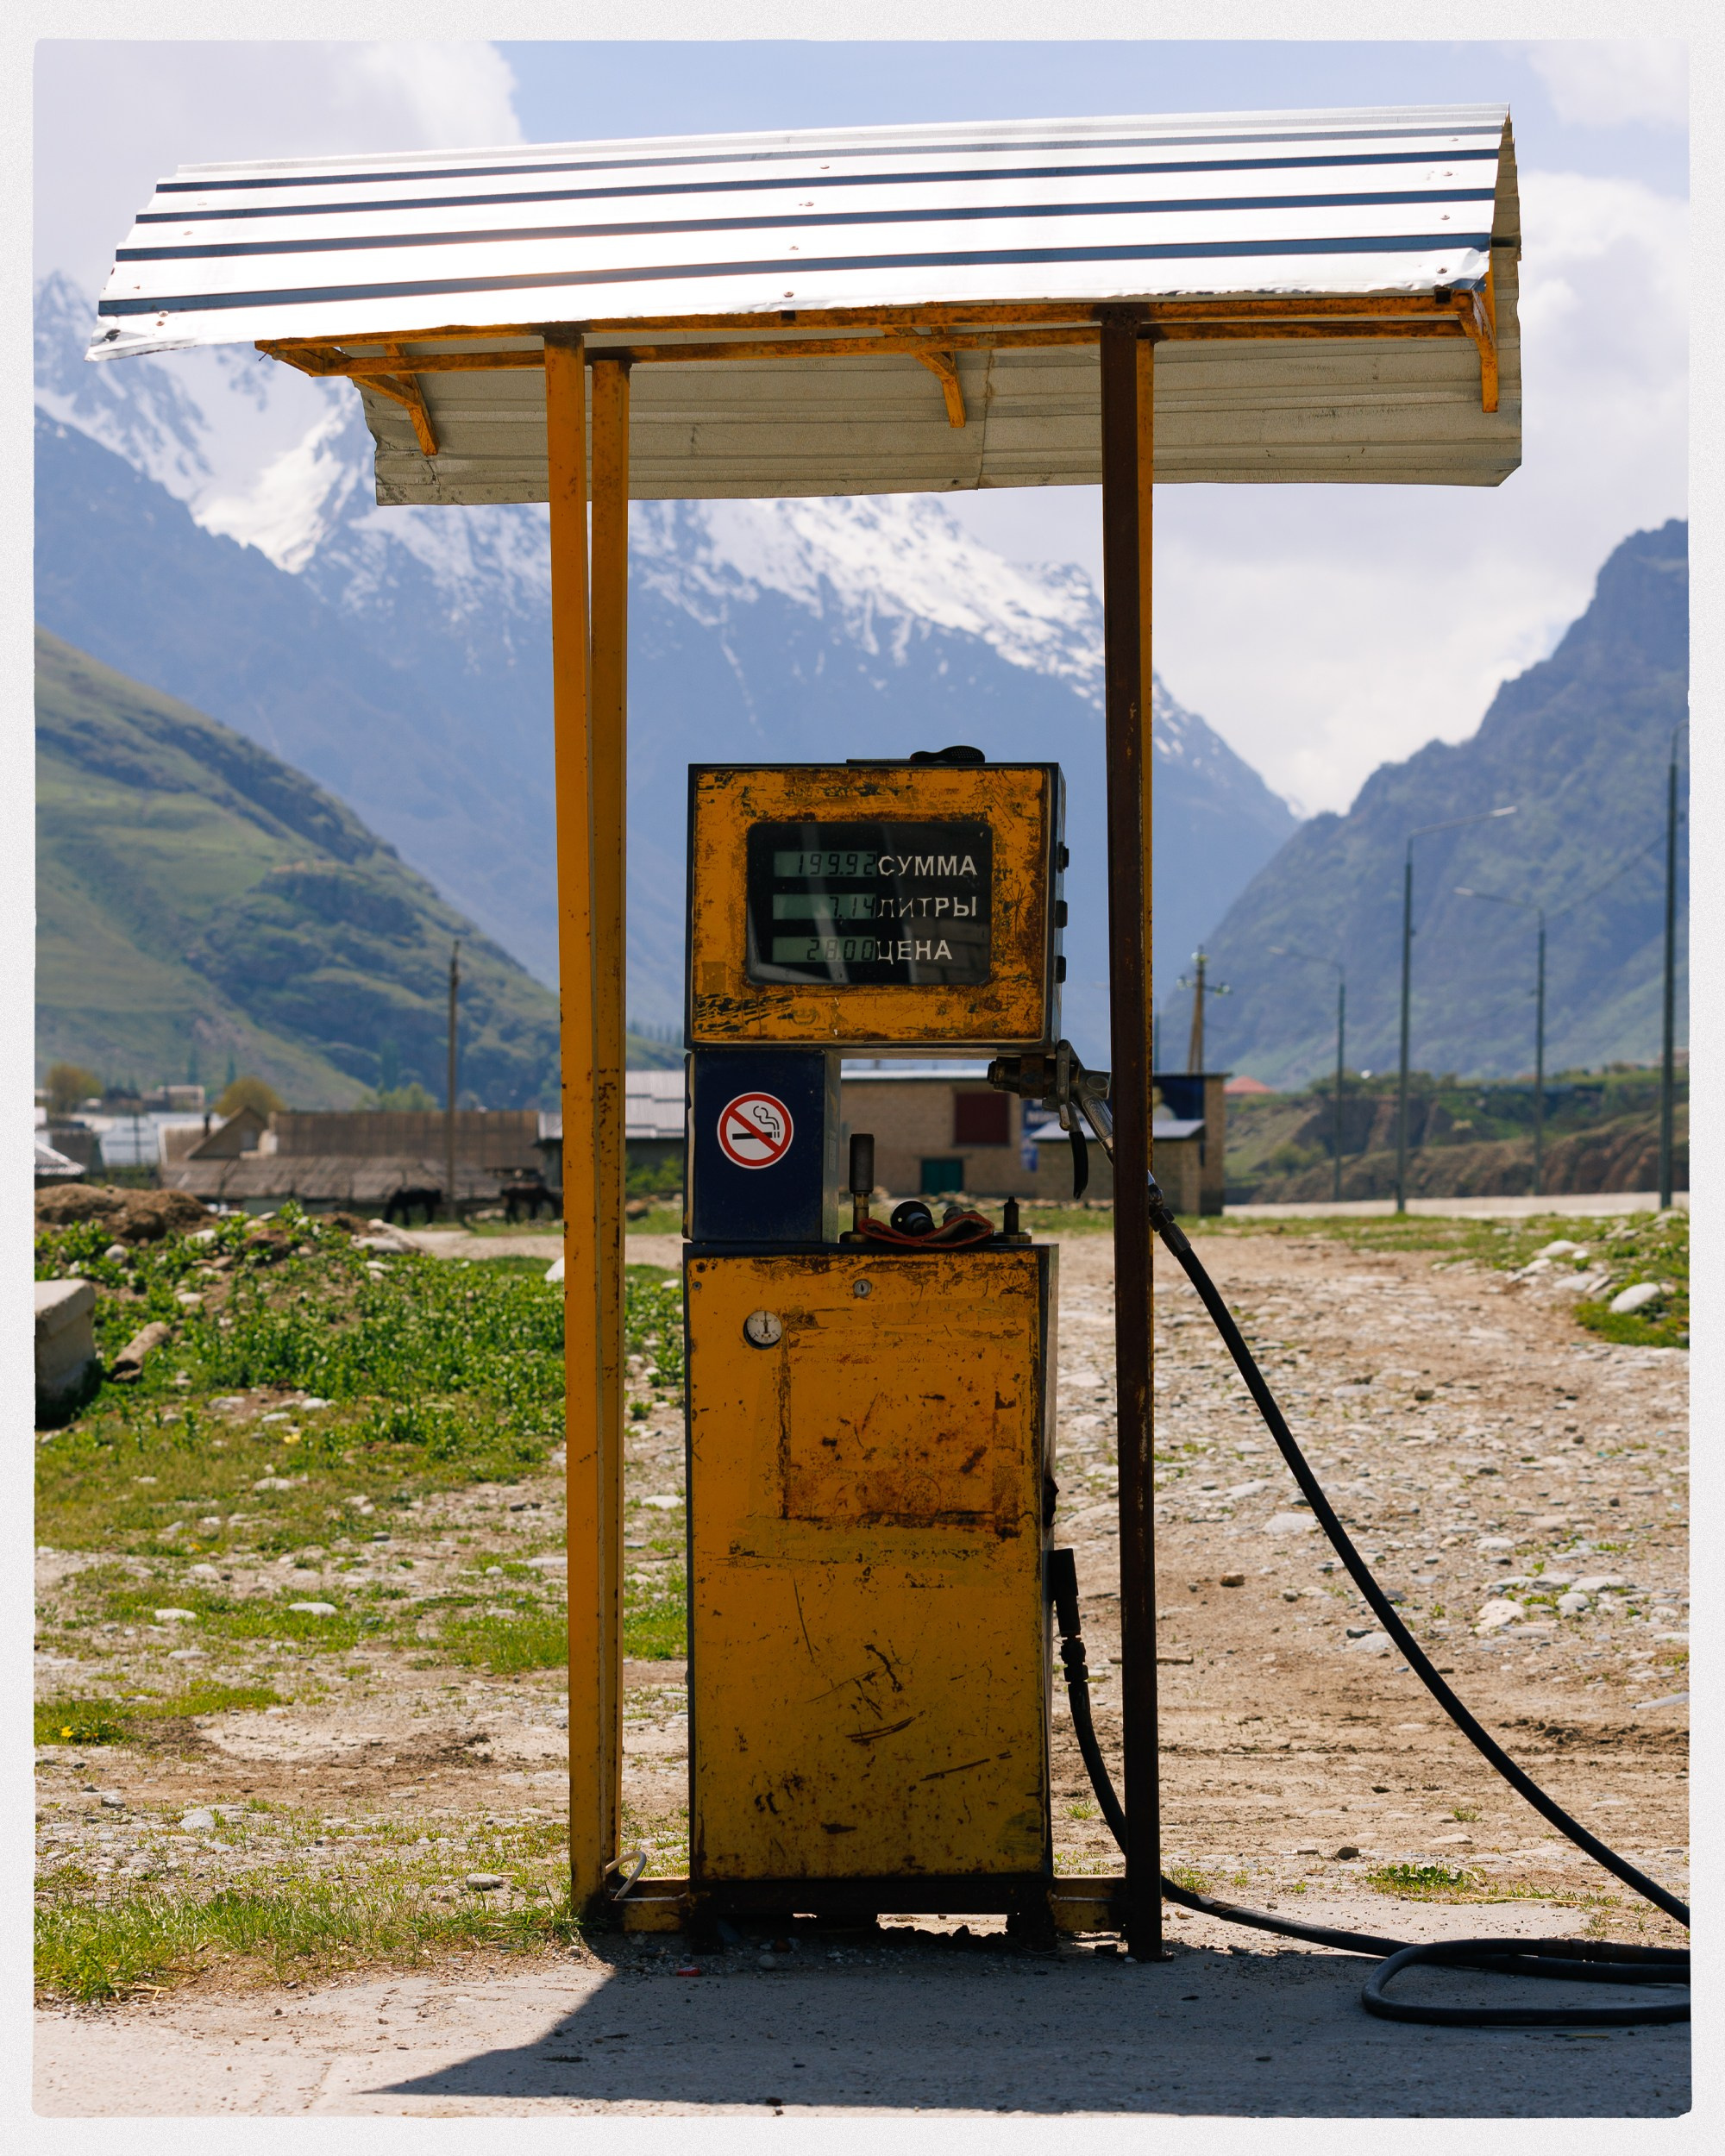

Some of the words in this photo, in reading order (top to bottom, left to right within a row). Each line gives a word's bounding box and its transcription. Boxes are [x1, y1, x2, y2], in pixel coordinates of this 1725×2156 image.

[798, 854, 875, 875] 199.92
[877, 855, 977, 877] СУММА
[829, 897, 875, 918] 7.14
[877, 896, 977, 918] ЛИТРЫ
[806, 939, 875, 961] 28.00
[876, 939, 953, 965] ЦЕНА
